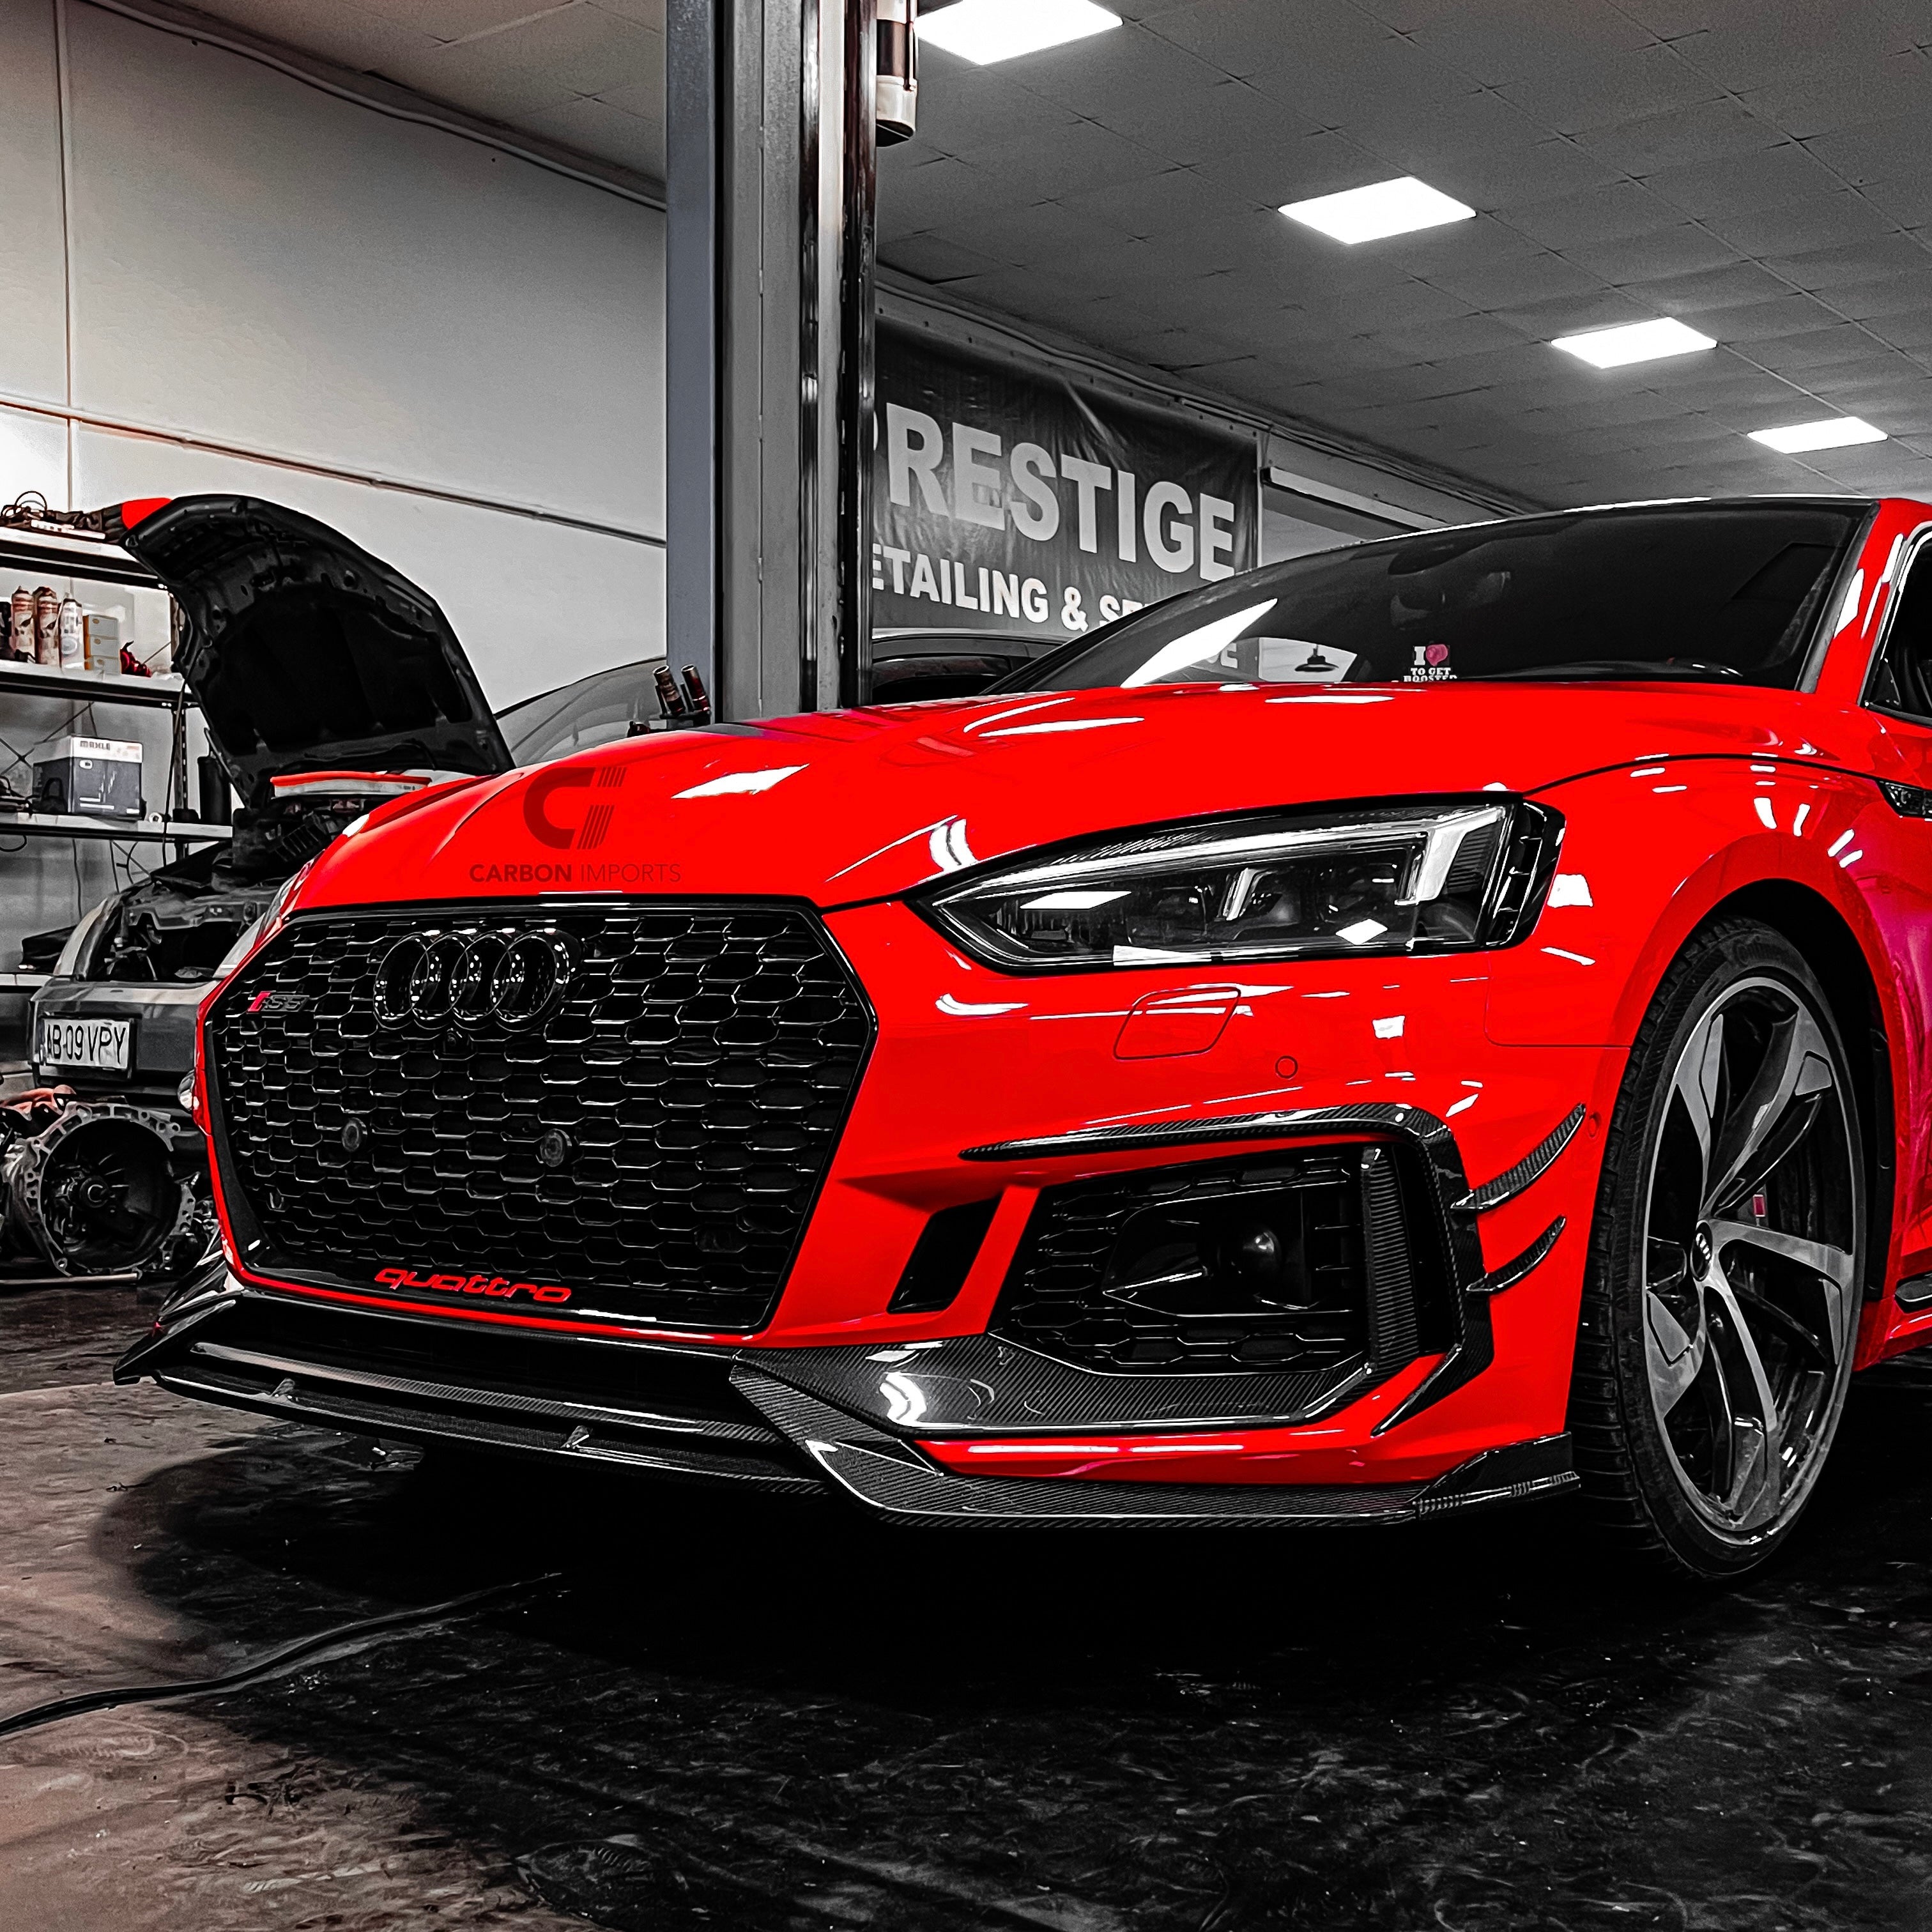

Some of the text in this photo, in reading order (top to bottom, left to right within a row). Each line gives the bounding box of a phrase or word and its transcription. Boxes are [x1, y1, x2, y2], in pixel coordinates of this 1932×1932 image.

[873, 402, 1235, 583] RESTIGE
[1061, 585, 1089, 632] &
[1410, 667, 1451, 675] TO GET
[1414, 646, 1426, 666] I
[374, 1268, 572, 1303] quattro
